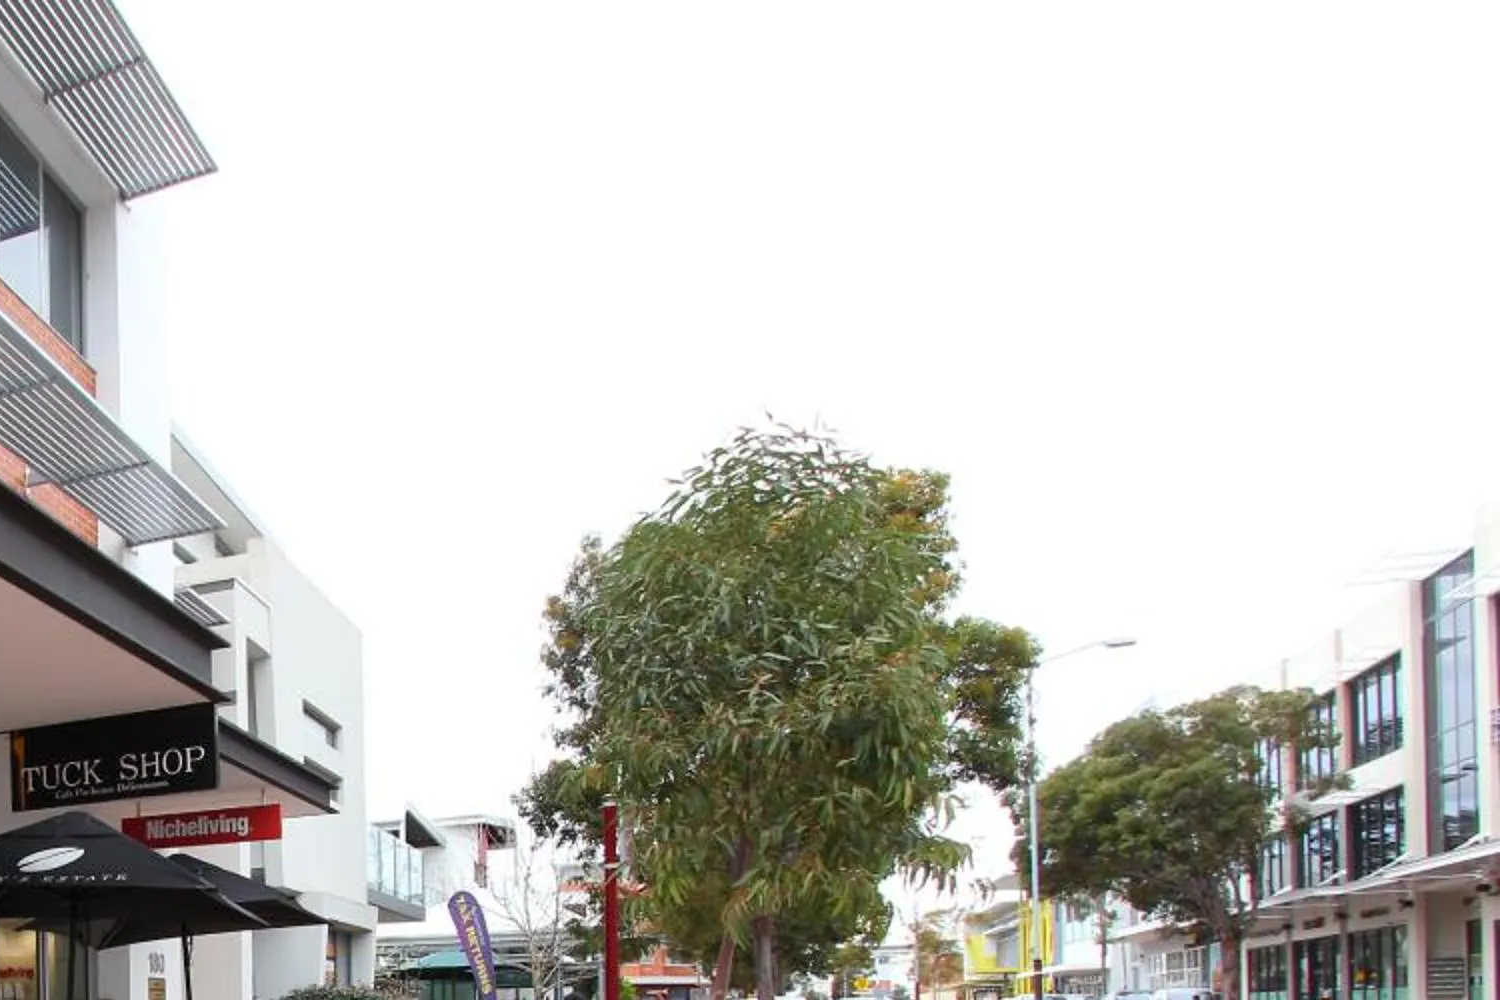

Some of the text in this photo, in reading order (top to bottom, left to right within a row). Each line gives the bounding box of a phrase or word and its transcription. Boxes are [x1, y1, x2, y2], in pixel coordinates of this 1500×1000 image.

[21, 745, 205, 793] TUCK SHOP
[466, 925, 493, 995] RETURNS
